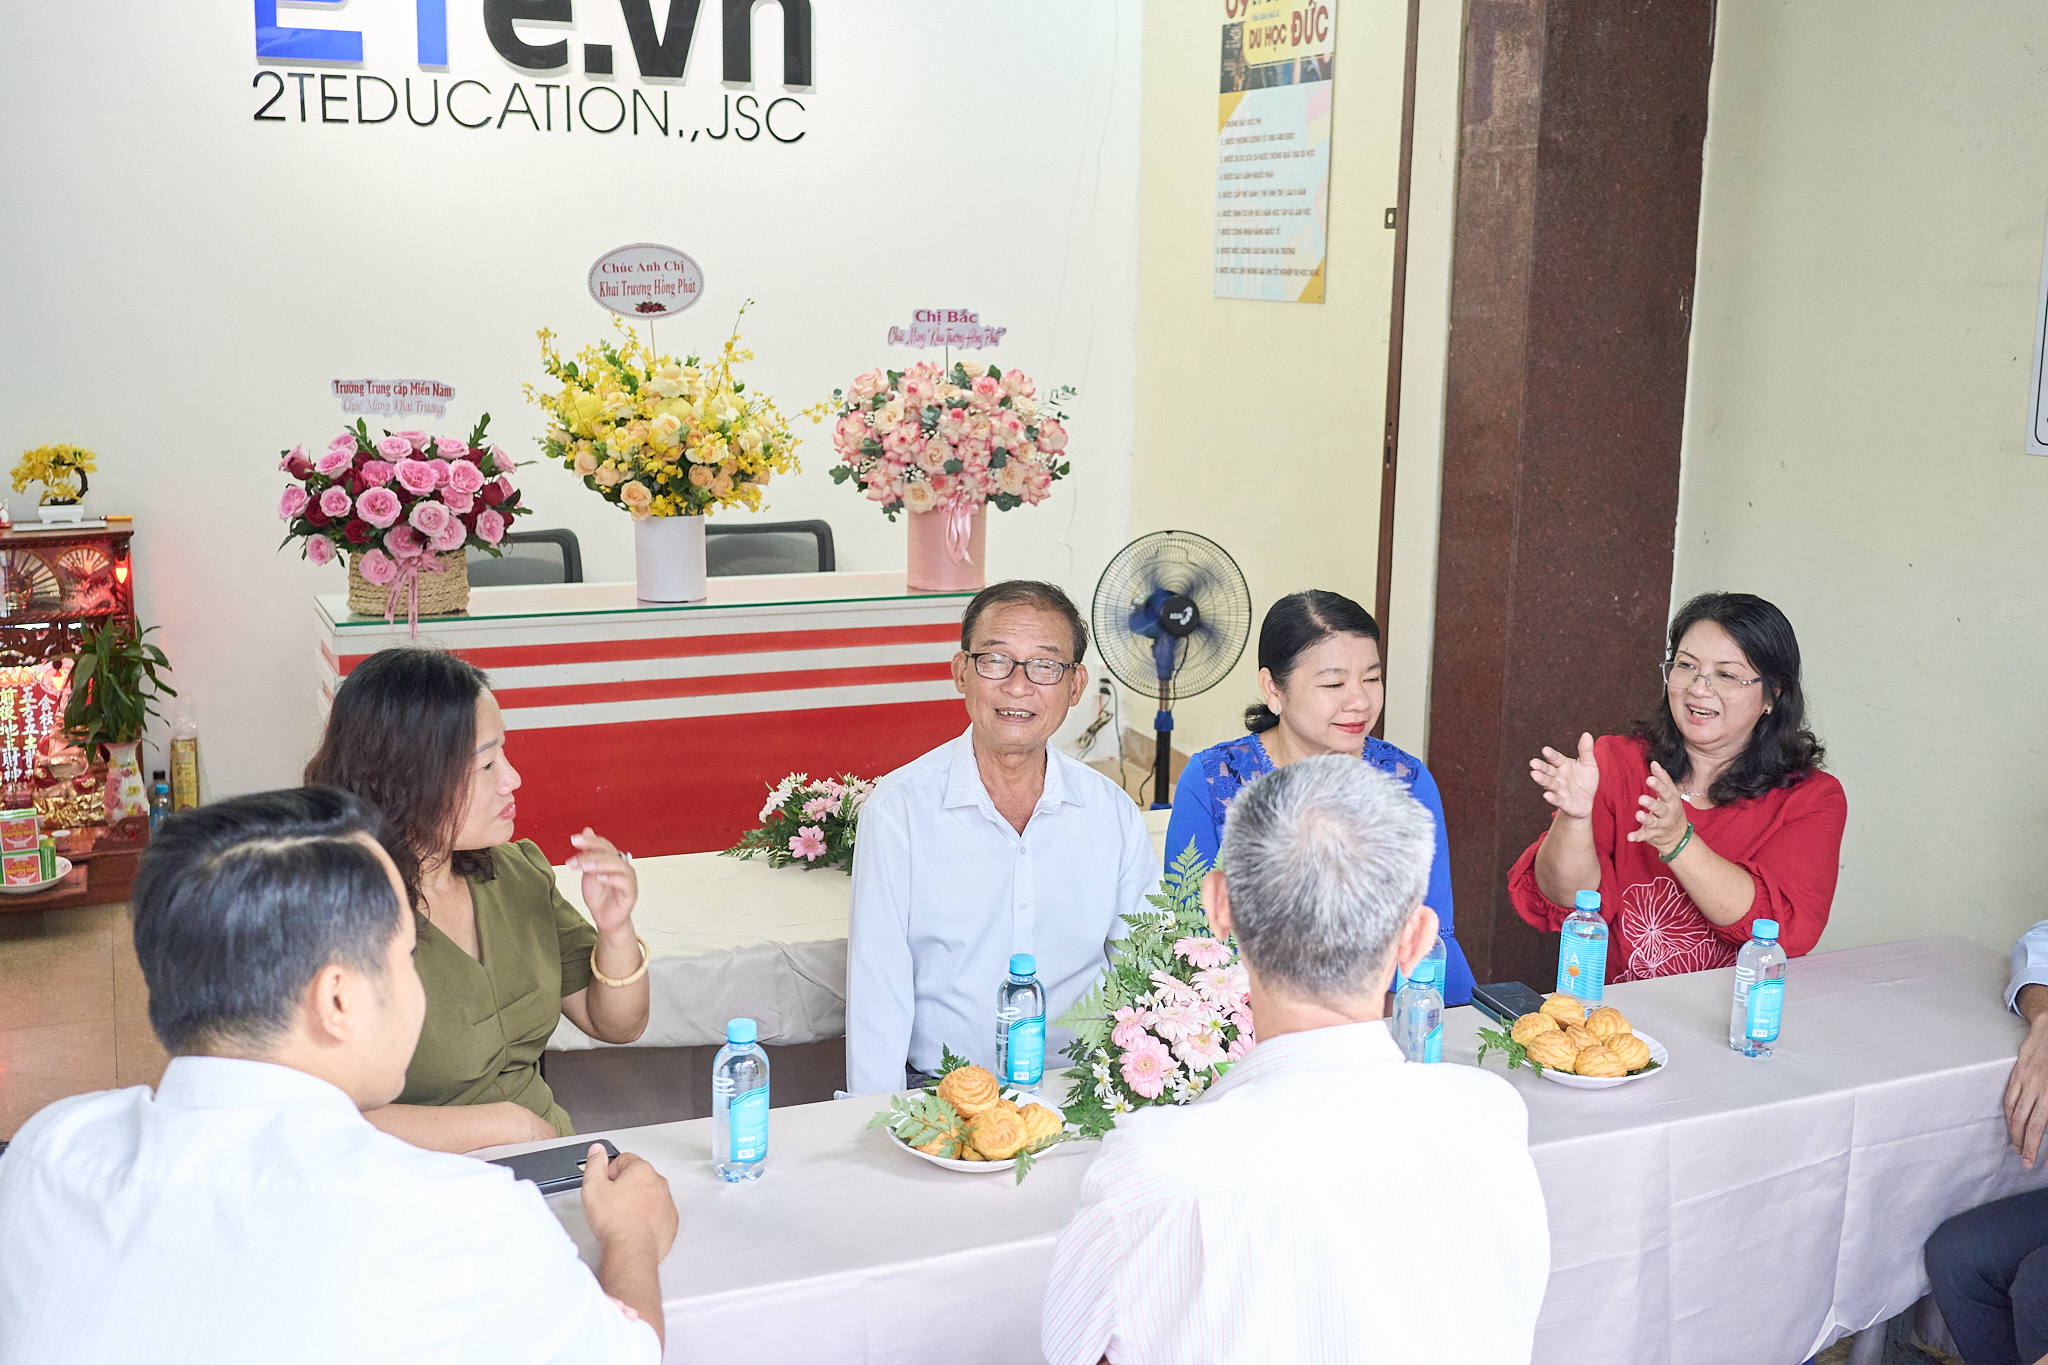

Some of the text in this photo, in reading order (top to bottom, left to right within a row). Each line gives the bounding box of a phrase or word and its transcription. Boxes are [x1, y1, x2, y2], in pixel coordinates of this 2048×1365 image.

[1249, 28, 1263, 49] DU
[1264, 23, 1287, 52] HỌC
[1291, 0, 1329, 47] ĐỨC
[602, 260, 684, 274] Chúc Anh Chị
[600, 274, 696, 299] Khai Trương Hồng Phát
[915, 309, 978, 325] Chị Bắc
[366, 380, 391, 397] Trung
[393, 381, 408, 398] cấp
[432, 383, 452, 397] Nam
